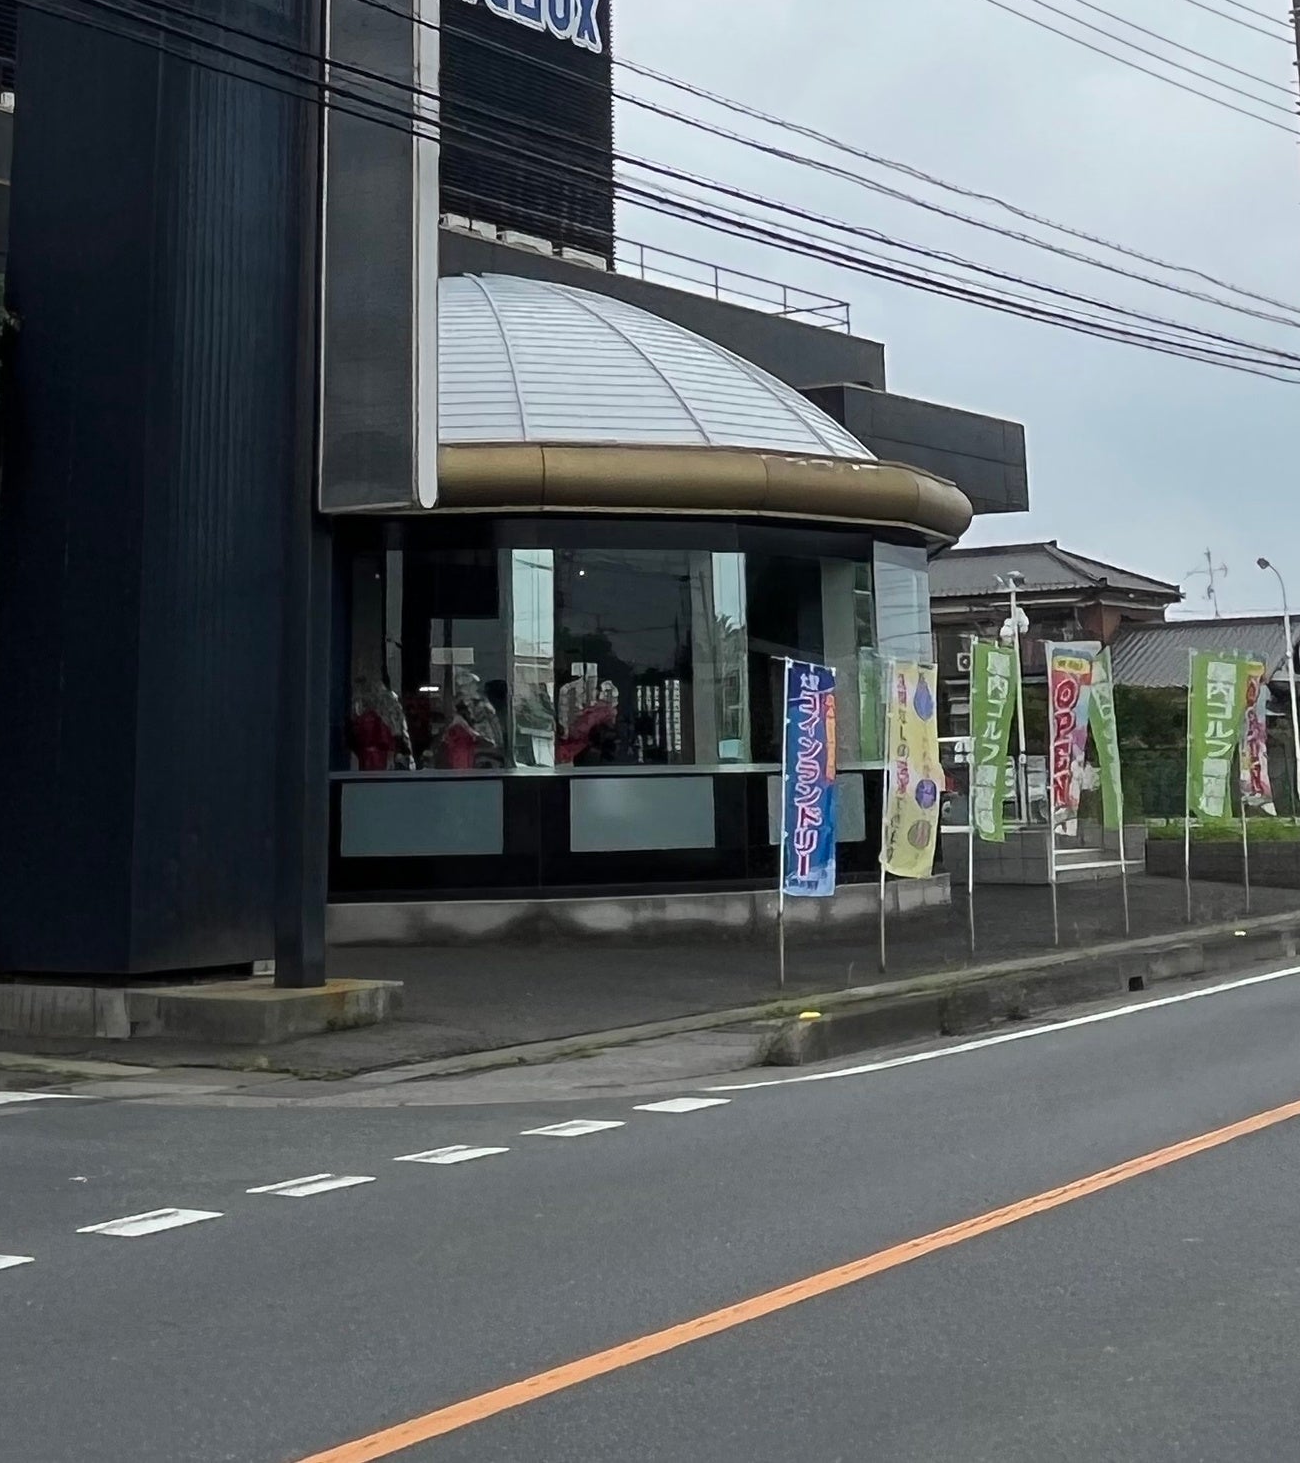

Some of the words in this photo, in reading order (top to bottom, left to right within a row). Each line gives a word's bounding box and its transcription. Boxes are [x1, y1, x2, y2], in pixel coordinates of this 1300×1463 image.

[794, 691, 823, 877] コインランドリー
[1054, 678, 1079, 809] OPEN
